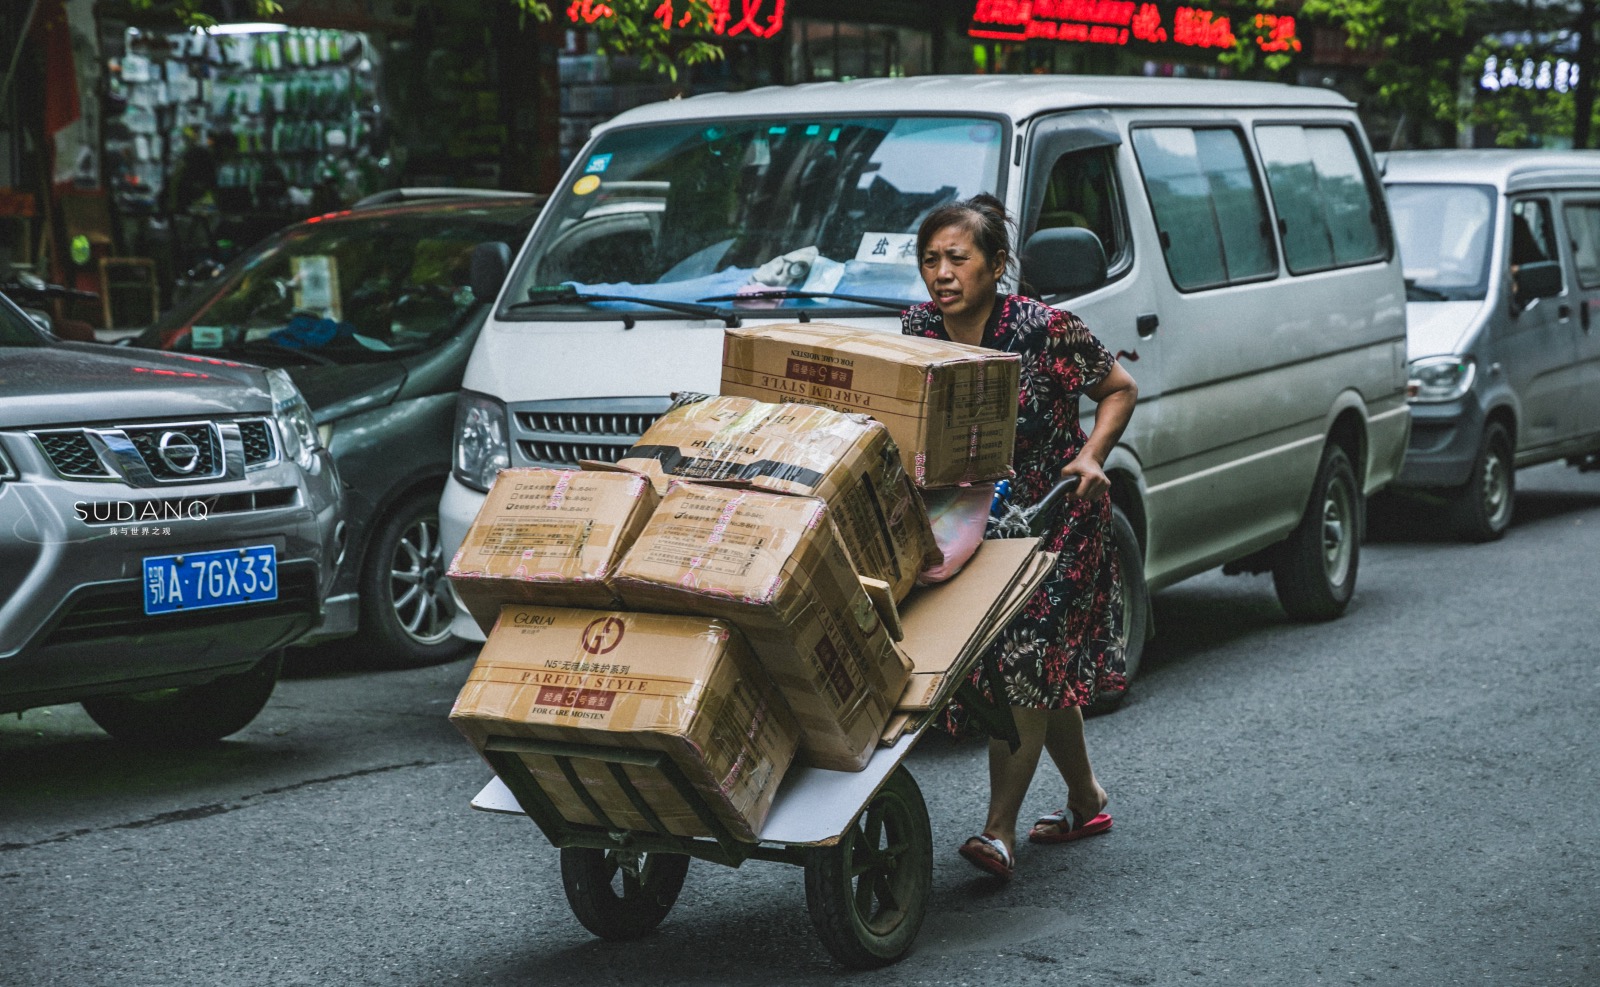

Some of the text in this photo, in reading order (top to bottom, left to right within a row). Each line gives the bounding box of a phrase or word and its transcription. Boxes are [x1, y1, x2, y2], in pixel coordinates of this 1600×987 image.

[821, 355, 840, 365] CARE
[840, 358, 854, 367] FOR
[761, 376, 871, 406] PARFUM STYLE
[520, 672, 649, 692] PARFUM STYLE
[542, 690, 608, 707] 经典5号香型
[532, 707, 605, 720] FOR CARE MOISTEN
